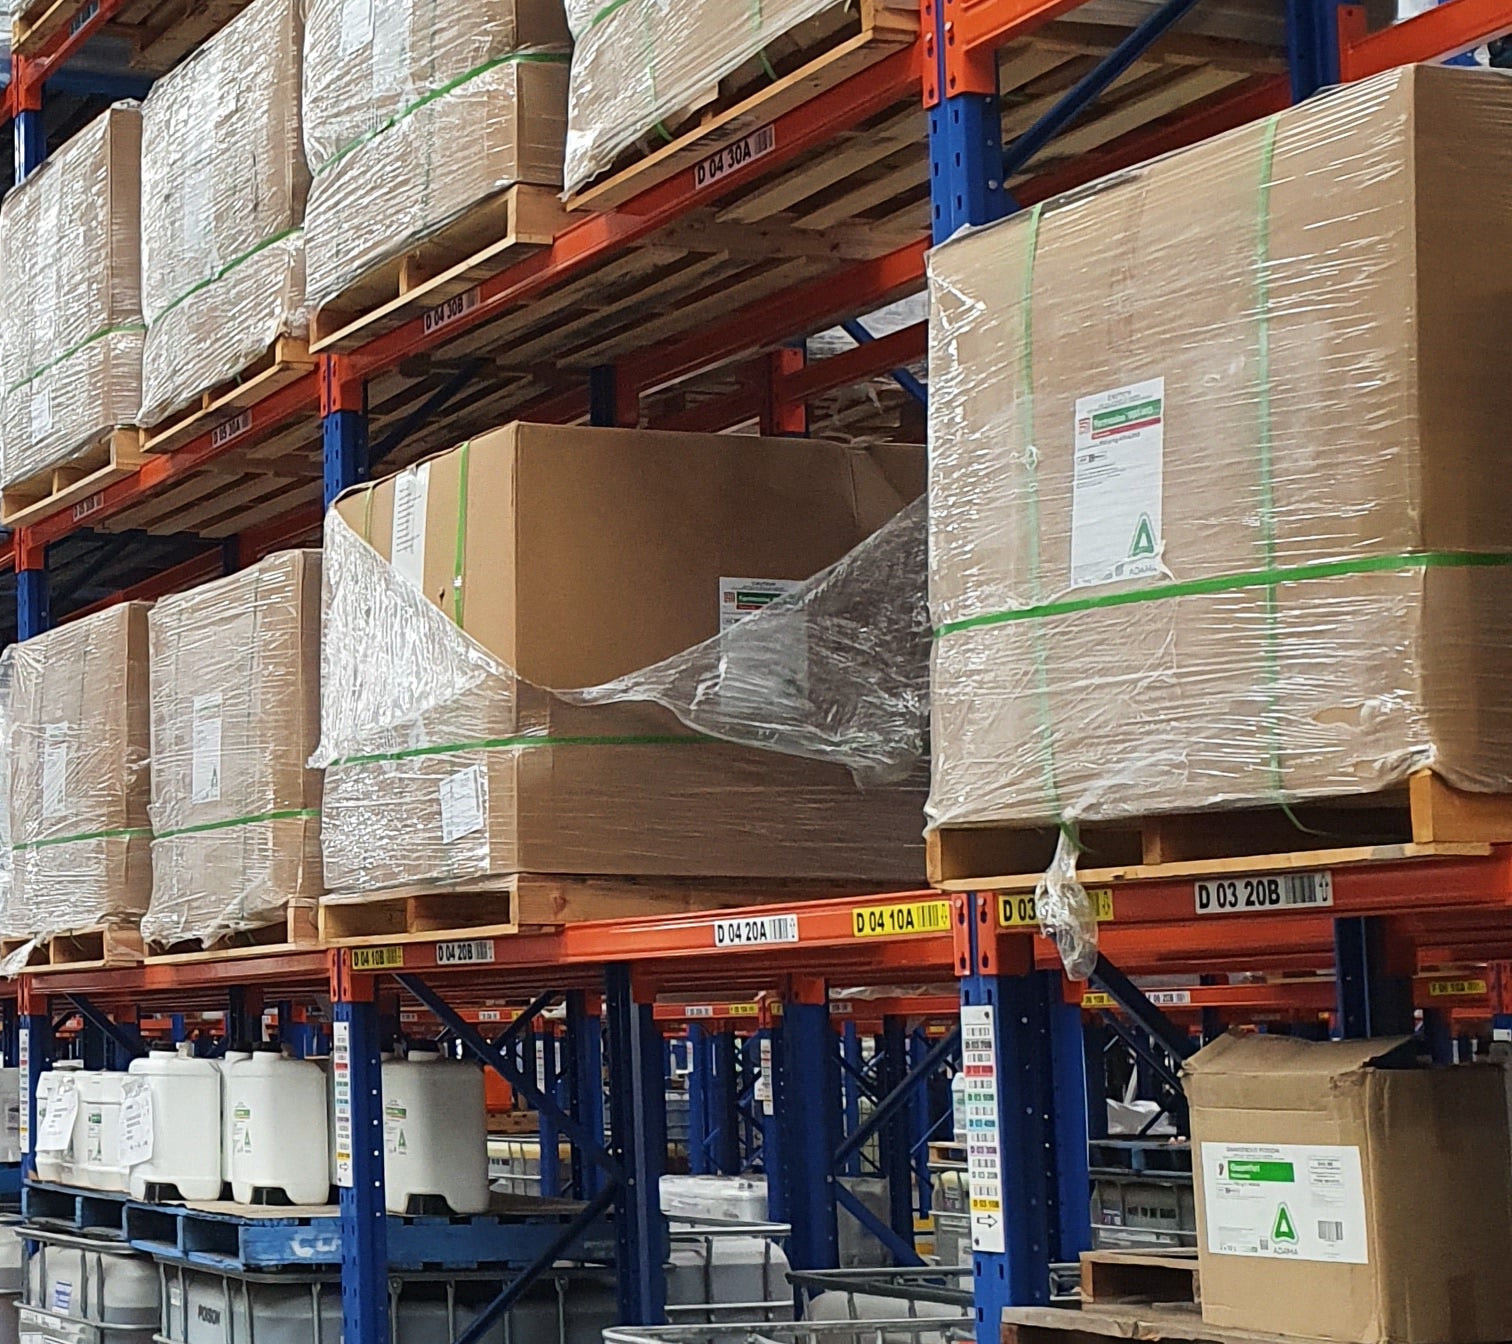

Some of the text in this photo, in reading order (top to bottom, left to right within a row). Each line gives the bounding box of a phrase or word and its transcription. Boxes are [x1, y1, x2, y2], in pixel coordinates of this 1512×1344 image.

[697, 139, 751, 185] D 04 30A
[426, 295, 463, 330] D 04 30B
[1198, 879, 1280, 909] D 03 20B
[856, 908, 914, 933] D 04 10A
[1003, 899, 1036, 921] D 03
[717, 921, 767, 943] D 04 20A
[354, 950, 385, 966] D 04 10B
[438, 943, 472, 962] D 04 20B
[197, 1303, 220, 1326] POISON
